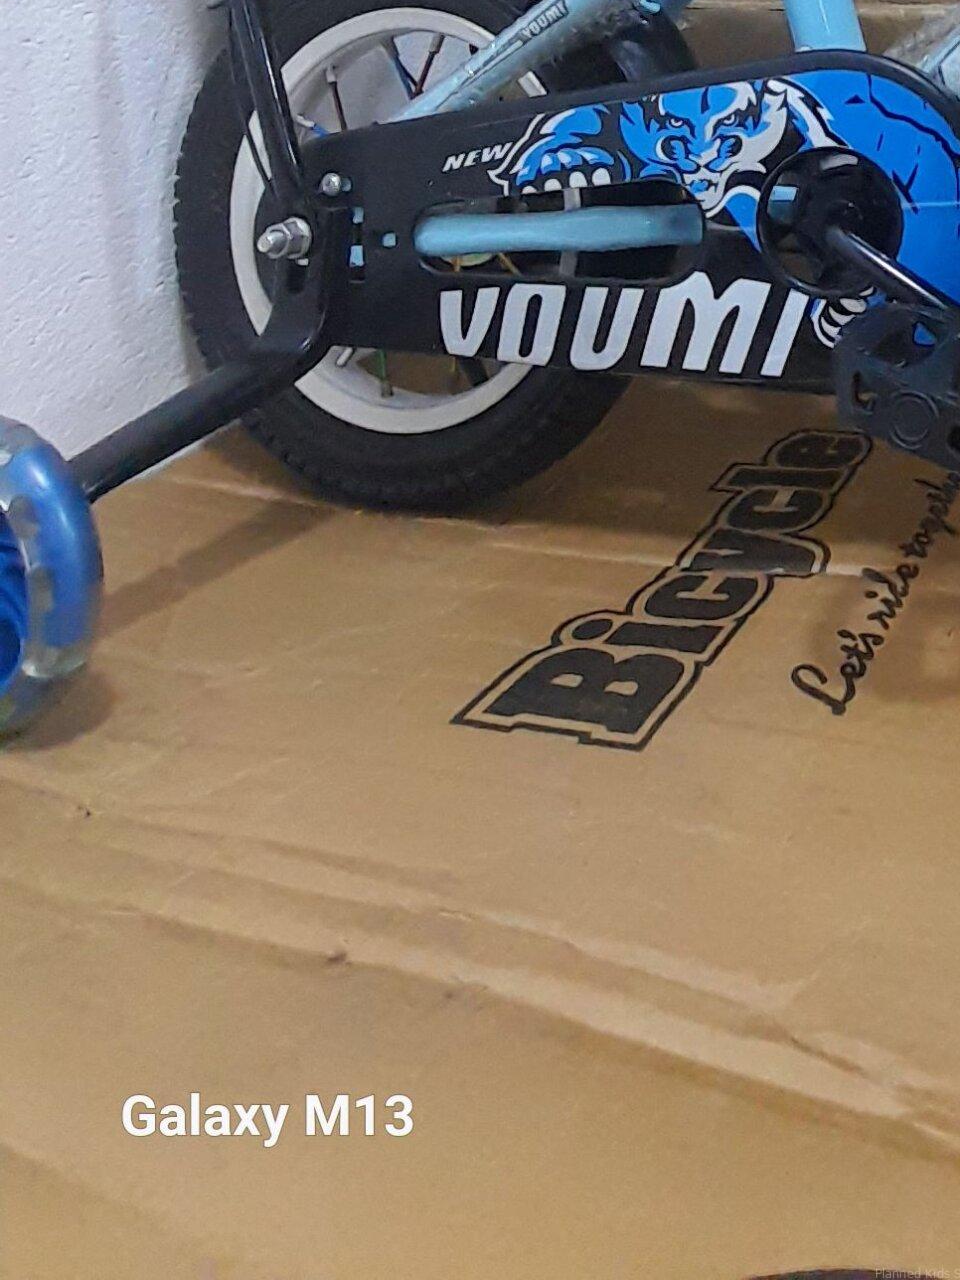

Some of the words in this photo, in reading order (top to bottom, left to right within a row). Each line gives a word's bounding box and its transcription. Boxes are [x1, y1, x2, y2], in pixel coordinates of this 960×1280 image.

[441, 141, 513, 173] NEW
[790, 629, 885, 716] Let's
[861, 563, 920, 630] ride
